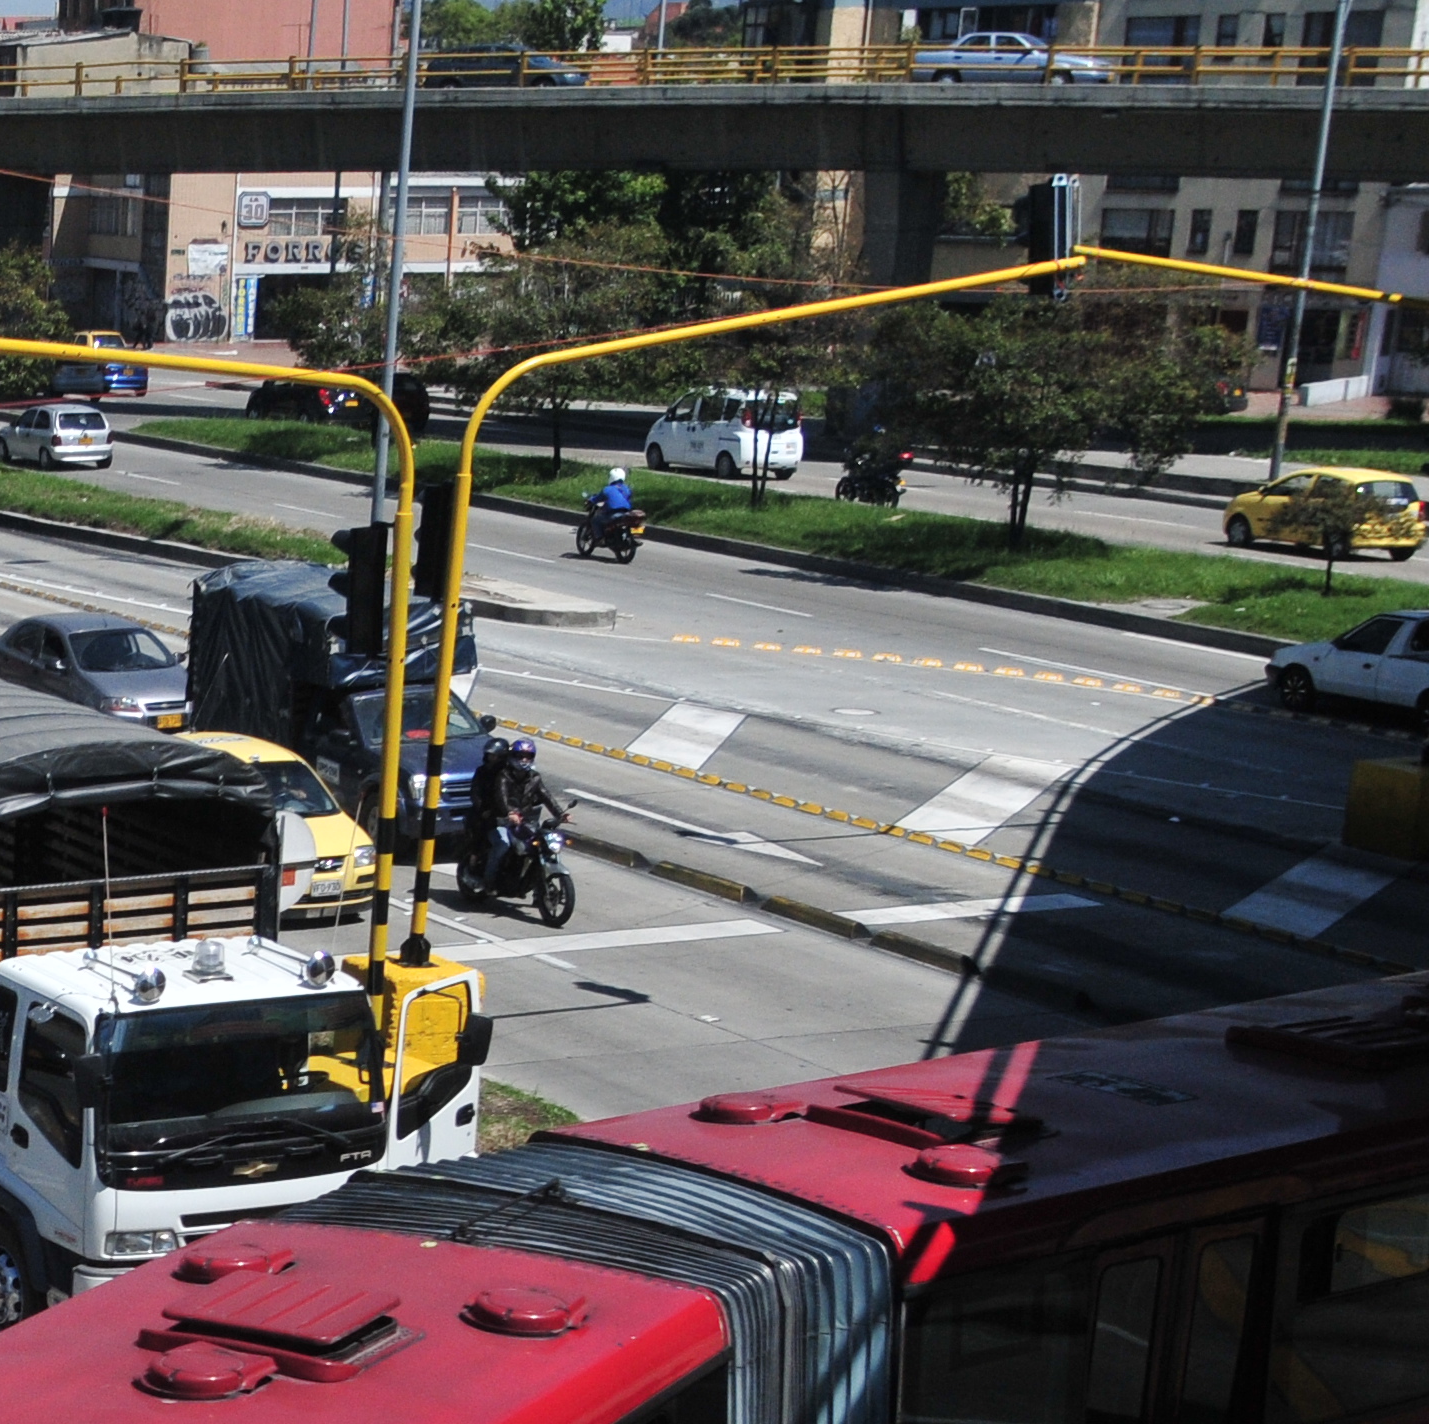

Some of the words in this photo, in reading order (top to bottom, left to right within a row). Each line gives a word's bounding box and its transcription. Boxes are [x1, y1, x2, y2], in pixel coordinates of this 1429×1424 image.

[242, 203, 265, 221] 30
[237, 278, 246, 334] FORROS
[339, 1149, 372, 1163] FTR
